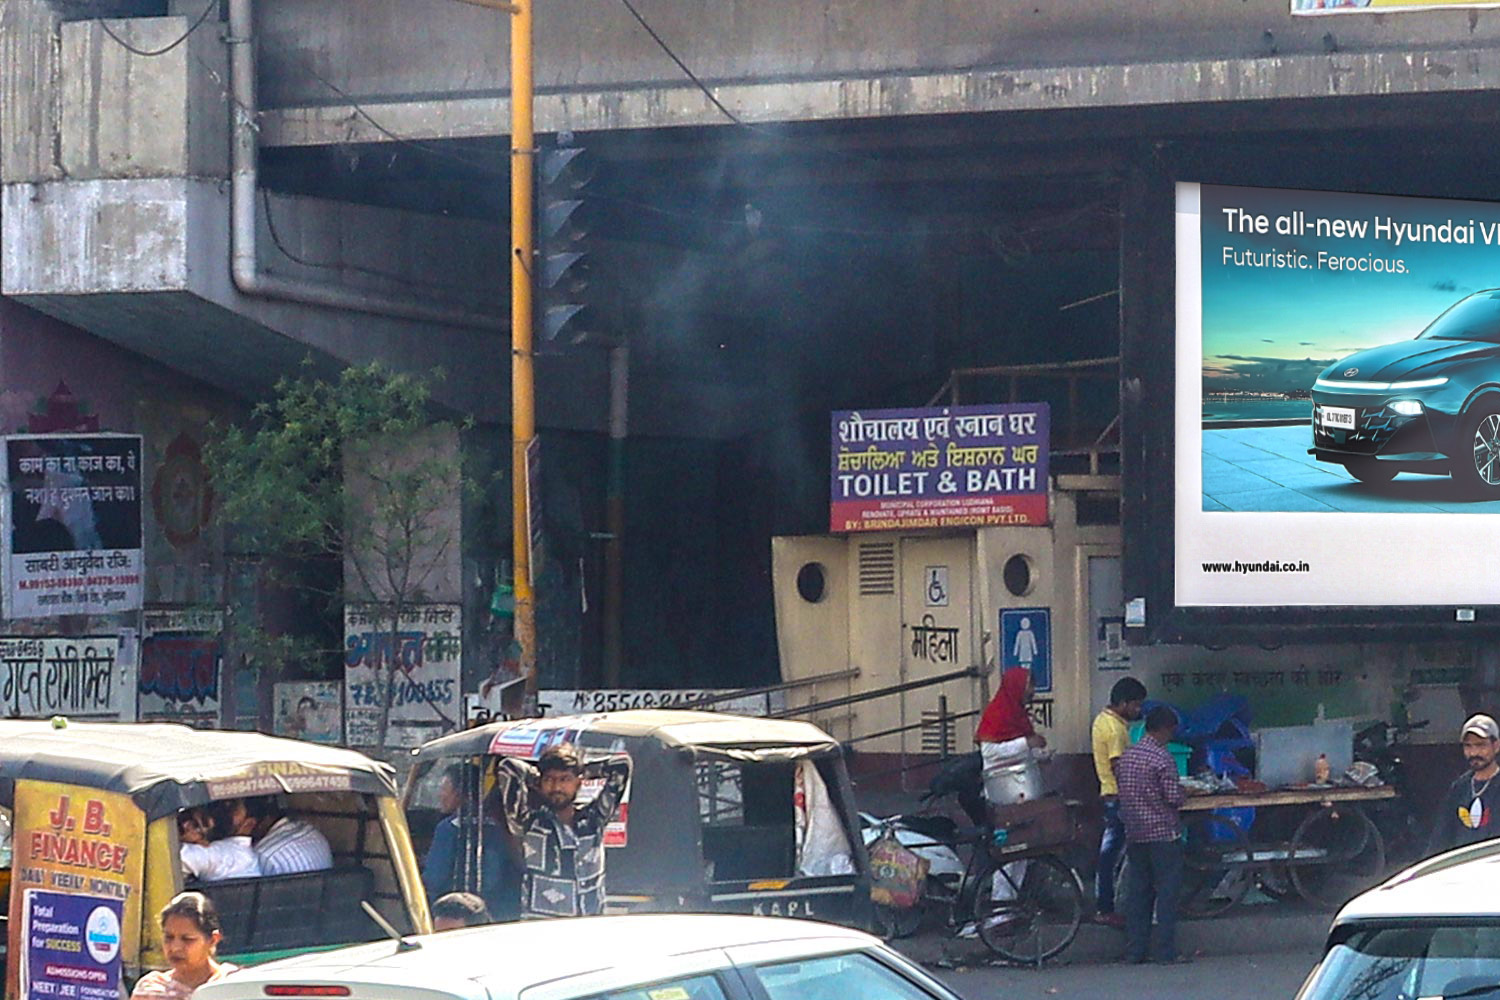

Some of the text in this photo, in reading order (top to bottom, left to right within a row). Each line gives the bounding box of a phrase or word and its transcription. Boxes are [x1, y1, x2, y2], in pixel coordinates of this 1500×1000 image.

[1222, 208, 1268, 233] The
[1276, 210, 1368, 239] all-new
[1374, 216, 1475, 246] Hyundai
[1222, 246, 1409, 274] Futuristic. Ferocious.
[839, 408, 1037, 442] शौचालय एवं स्नान घर
[838, 467, 1036, 498] TOILET & BATH
[845, 520, 862, 530] BY:
[1202, 559, 1310, 576] www.hyundai.co.in
[911, 613, 960, 664] महिला
[49, 794, 112, 836] J. B.
[31, 830, 128, 874] FINANCE
[33, 905, 55, 918] Total
[32, 919, 80, 935] Preparation
[32, 936, 44, 949] for
[45, 938, 82, 952] SUCCESS
[32, 981, 56, 994] NEET
[60, 983, 76, 997] JEE
